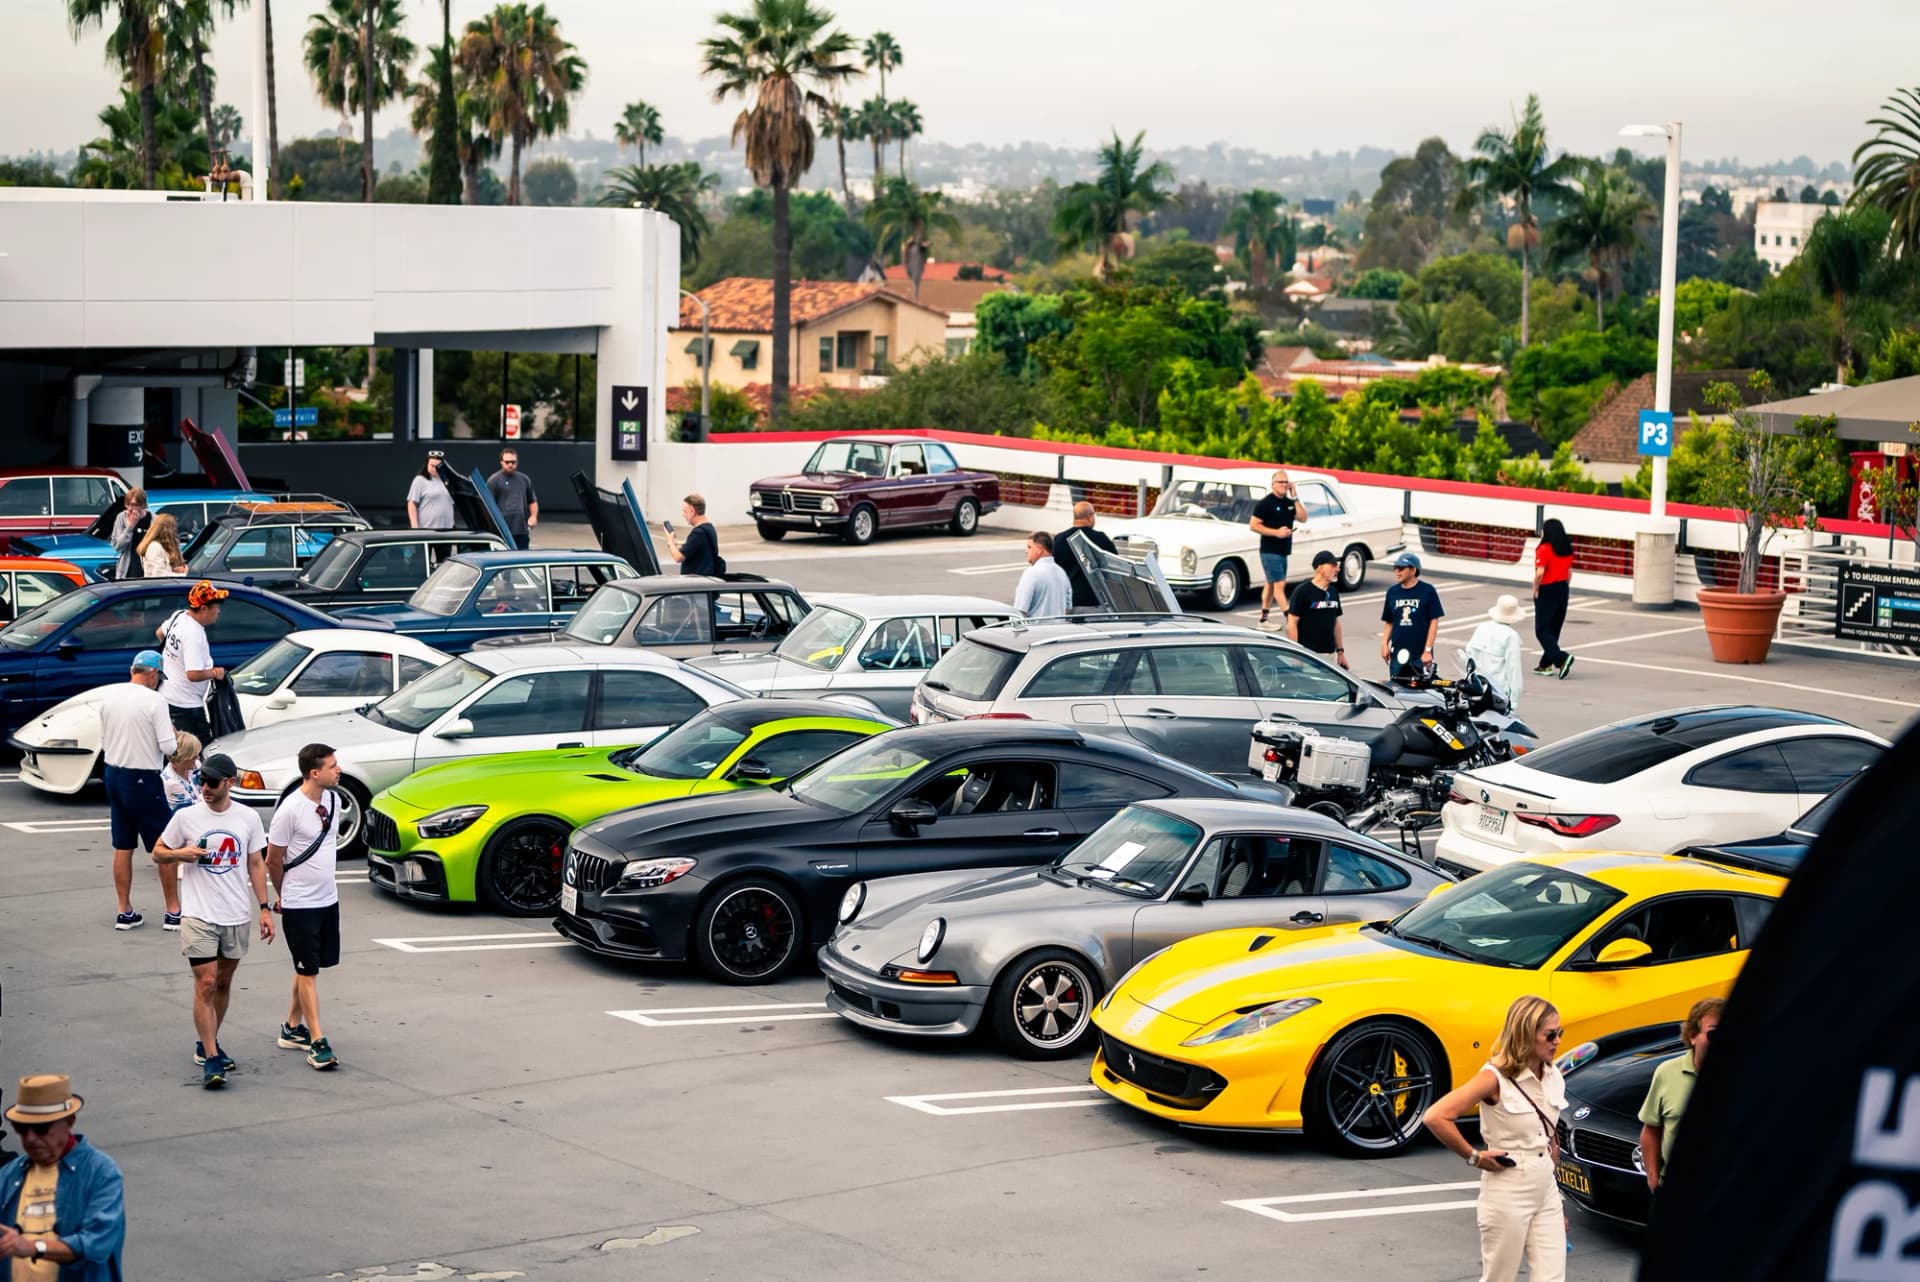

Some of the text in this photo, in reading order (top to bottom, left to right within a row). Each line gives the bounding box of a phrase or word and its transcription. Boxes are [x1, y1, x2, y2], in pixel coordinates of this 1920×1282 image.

[623, 421, 636, 432] P2
[1642, 421, 1668, 446] P3
[623, 433, 636, 443] P1
[1852, 571, 1862, 580] TO
[1862, 573, 1892, 583] MUSEUM
[1432, 723, 1455, 744] GS
[1556, 1167, 1591, 1195] SIKELIA
